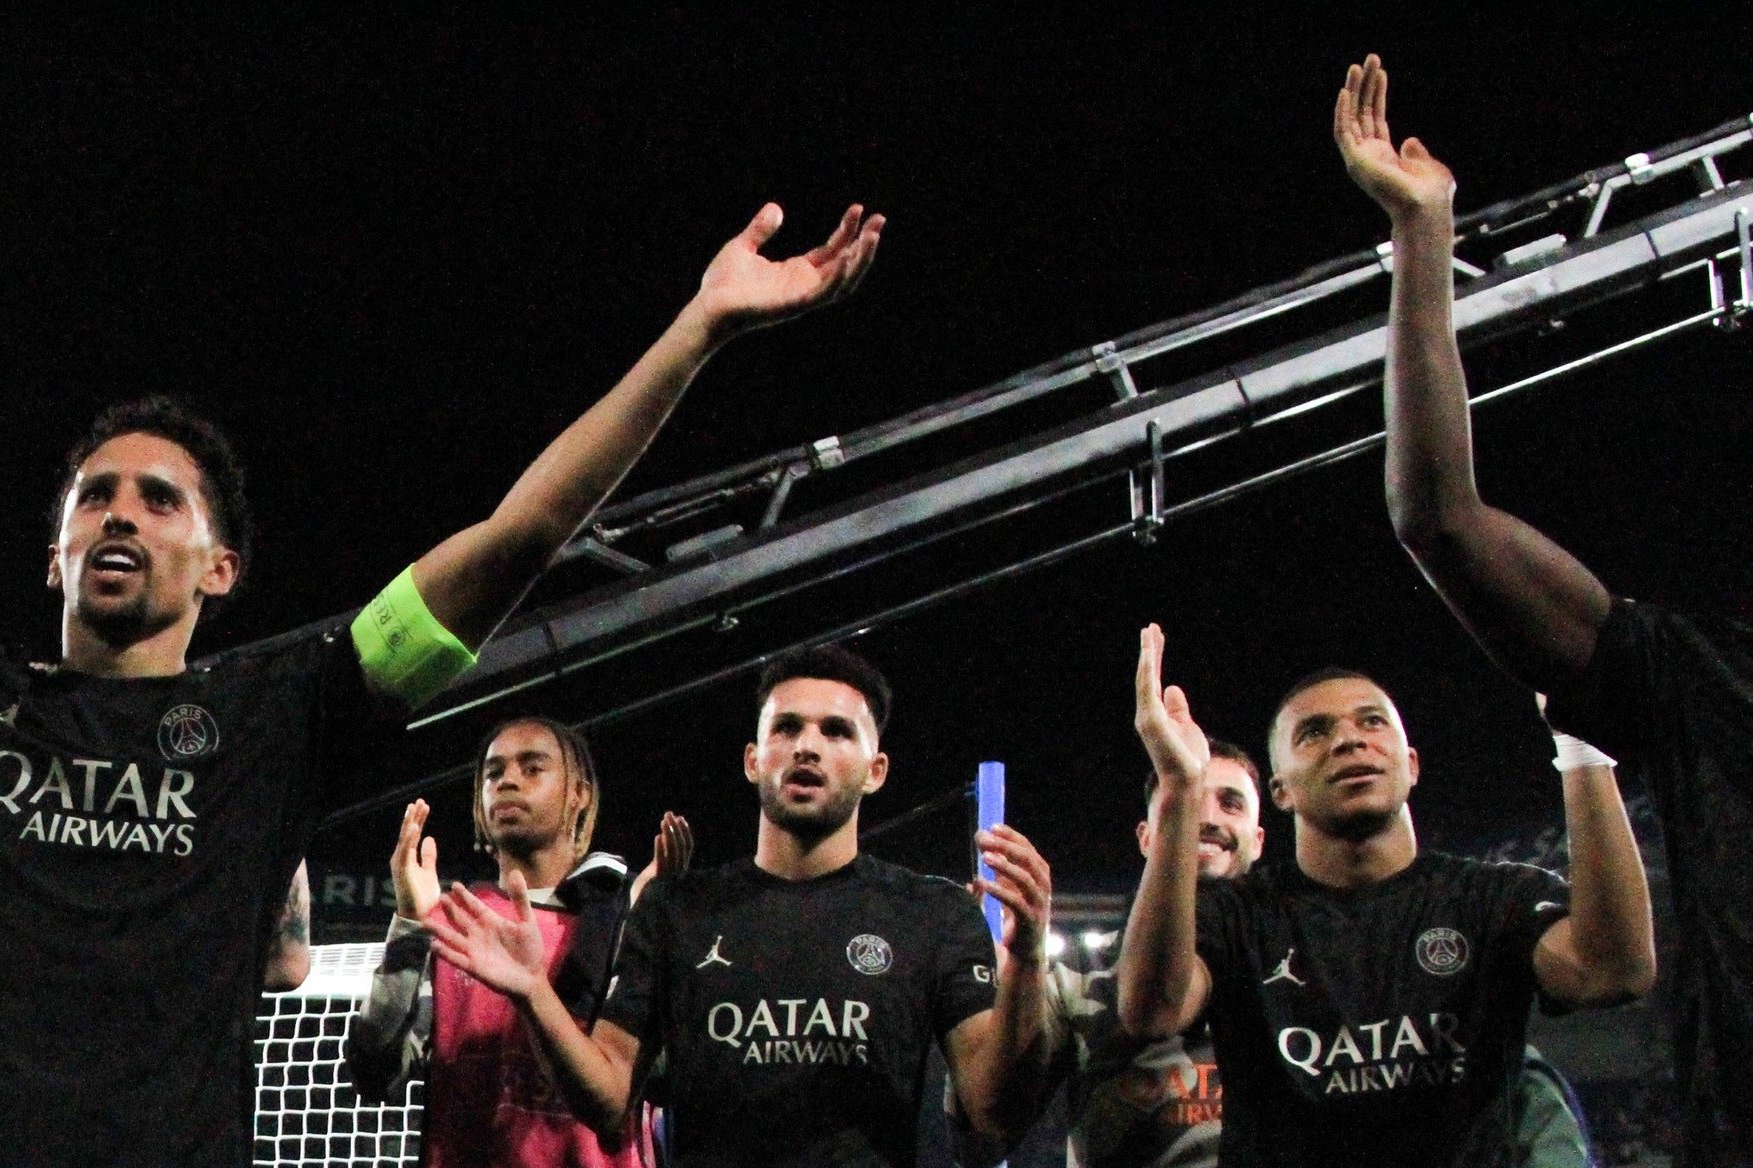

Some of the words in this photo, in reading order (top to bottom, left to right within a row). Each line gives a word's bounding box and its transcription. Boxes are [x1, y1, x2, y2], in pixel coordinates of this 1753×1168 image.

[163, 707, 204, 727] PARIS
[18, 810, 196, 857] AIRWAYS
[706, 997, 872, 1048] QATAR
[1277, 1011, 1467, 1077] QATAR
[742, 1040, 869, 1065] AIRWAYS
[1324, 1056, 1467, 1095] AIRWAYS
